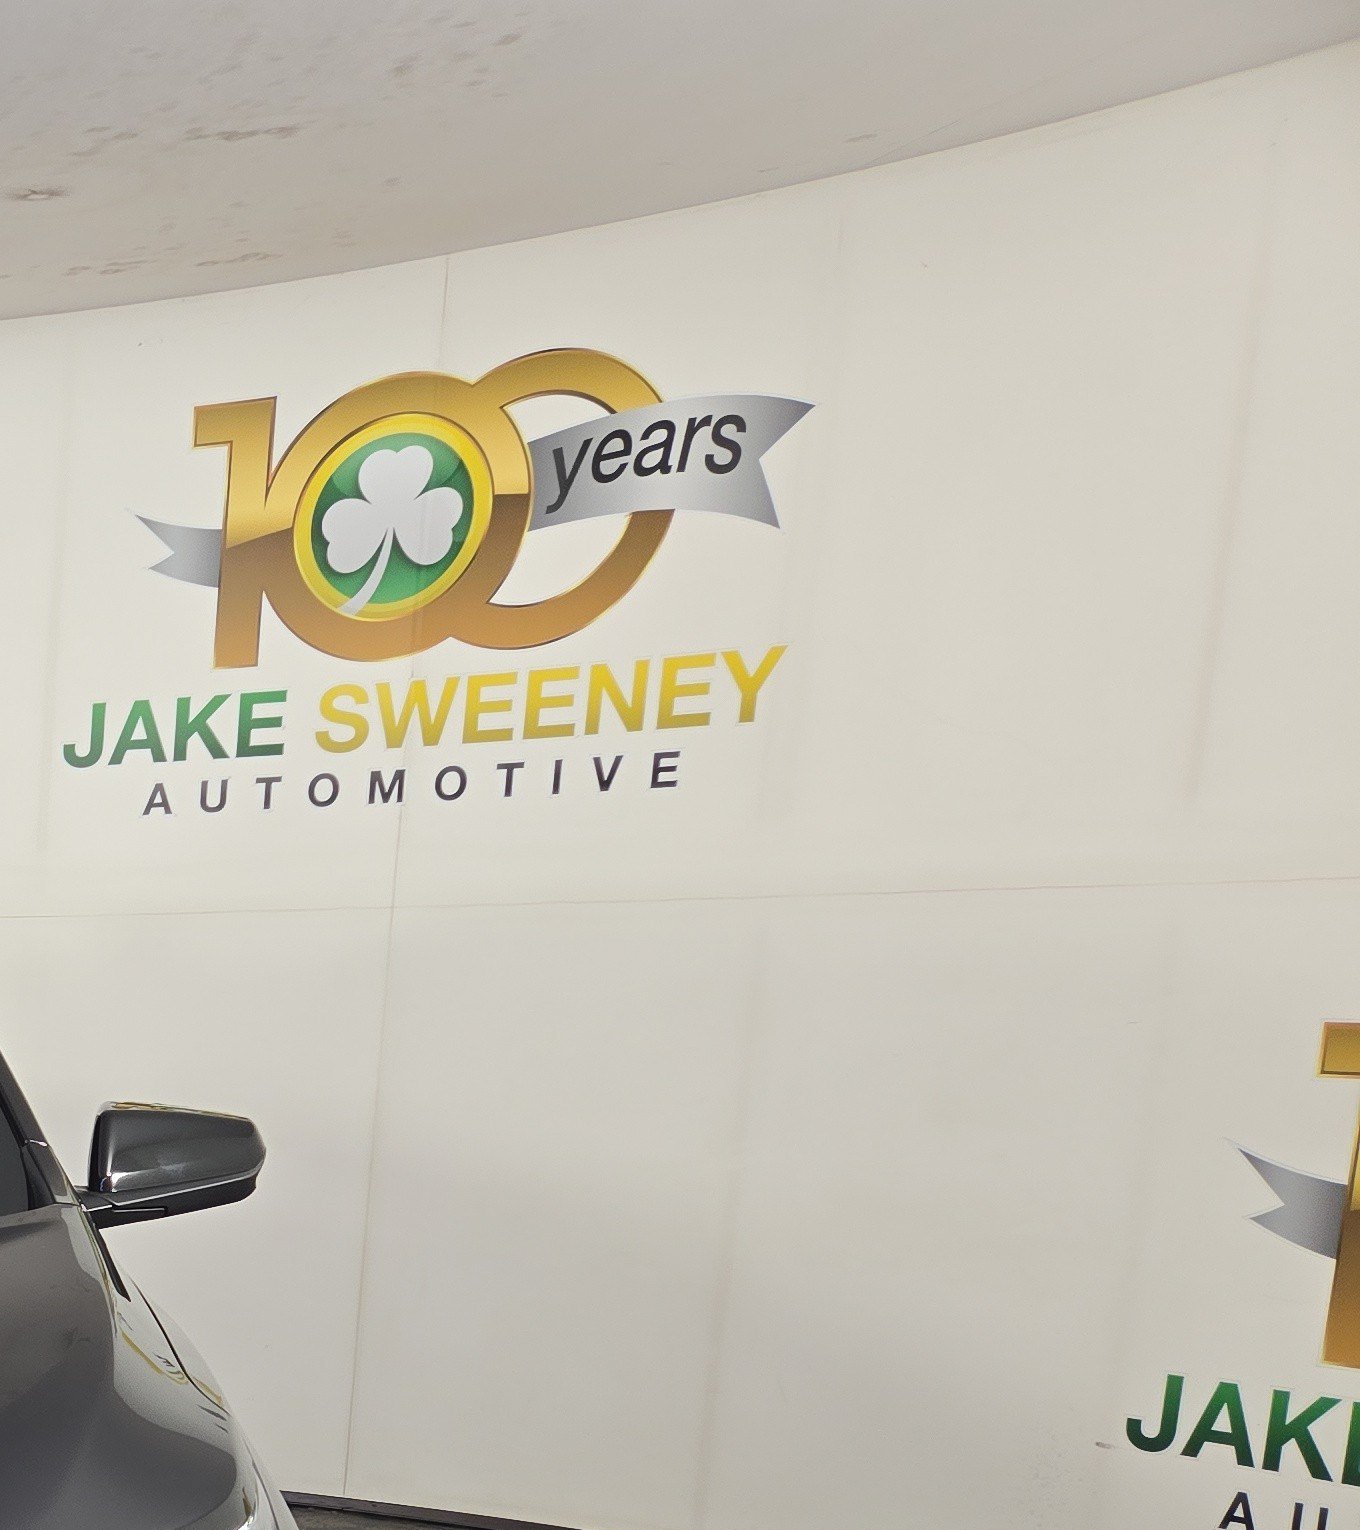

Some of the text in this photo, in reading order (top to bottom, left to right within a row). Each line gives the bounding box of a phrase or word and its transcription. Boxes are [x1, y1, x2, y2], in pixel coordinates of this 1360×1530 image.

[545, 412, 747, 514] years
[62, 644, 788, 769] JAKE SWEENEY
[142, 750, 681, 817] AUTOMOTIVE
